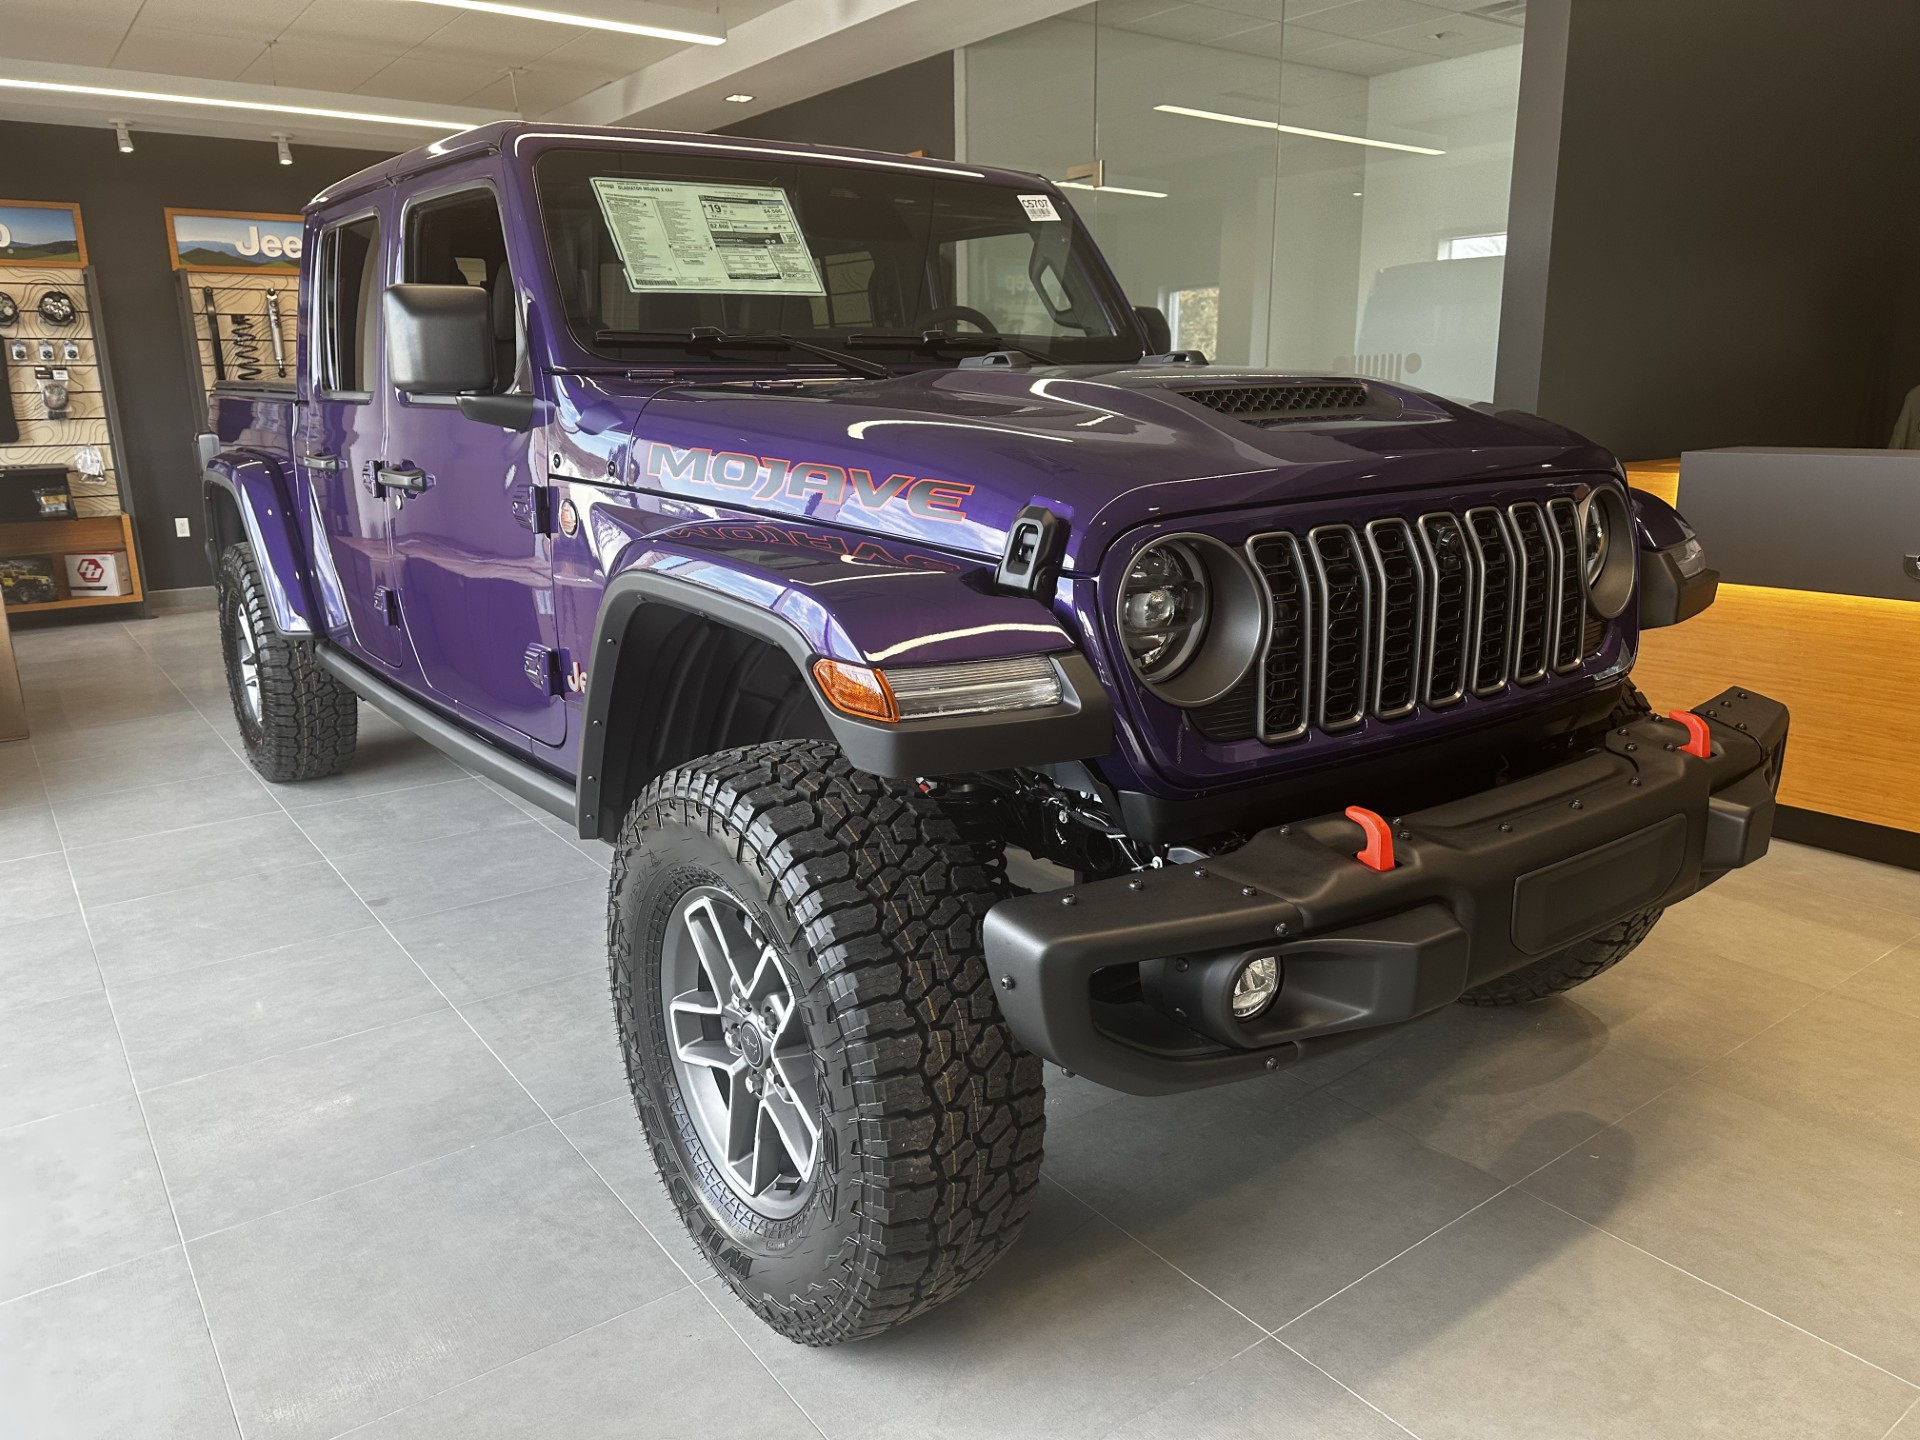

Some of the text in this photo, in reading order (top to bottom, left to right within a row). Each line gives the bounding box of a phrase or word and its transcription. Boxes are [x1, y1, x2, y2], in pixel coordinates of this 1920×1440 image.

[708, 203, 722, 213] 19
[1022, 199, 1048, 208] C5707
[235, 225, 302, 258] Jee
[646, 442, 975, 525] MOJAVE
[566, 661, 588, 694] Je
[623, 1020, 753, 1279] WILDPEAK
